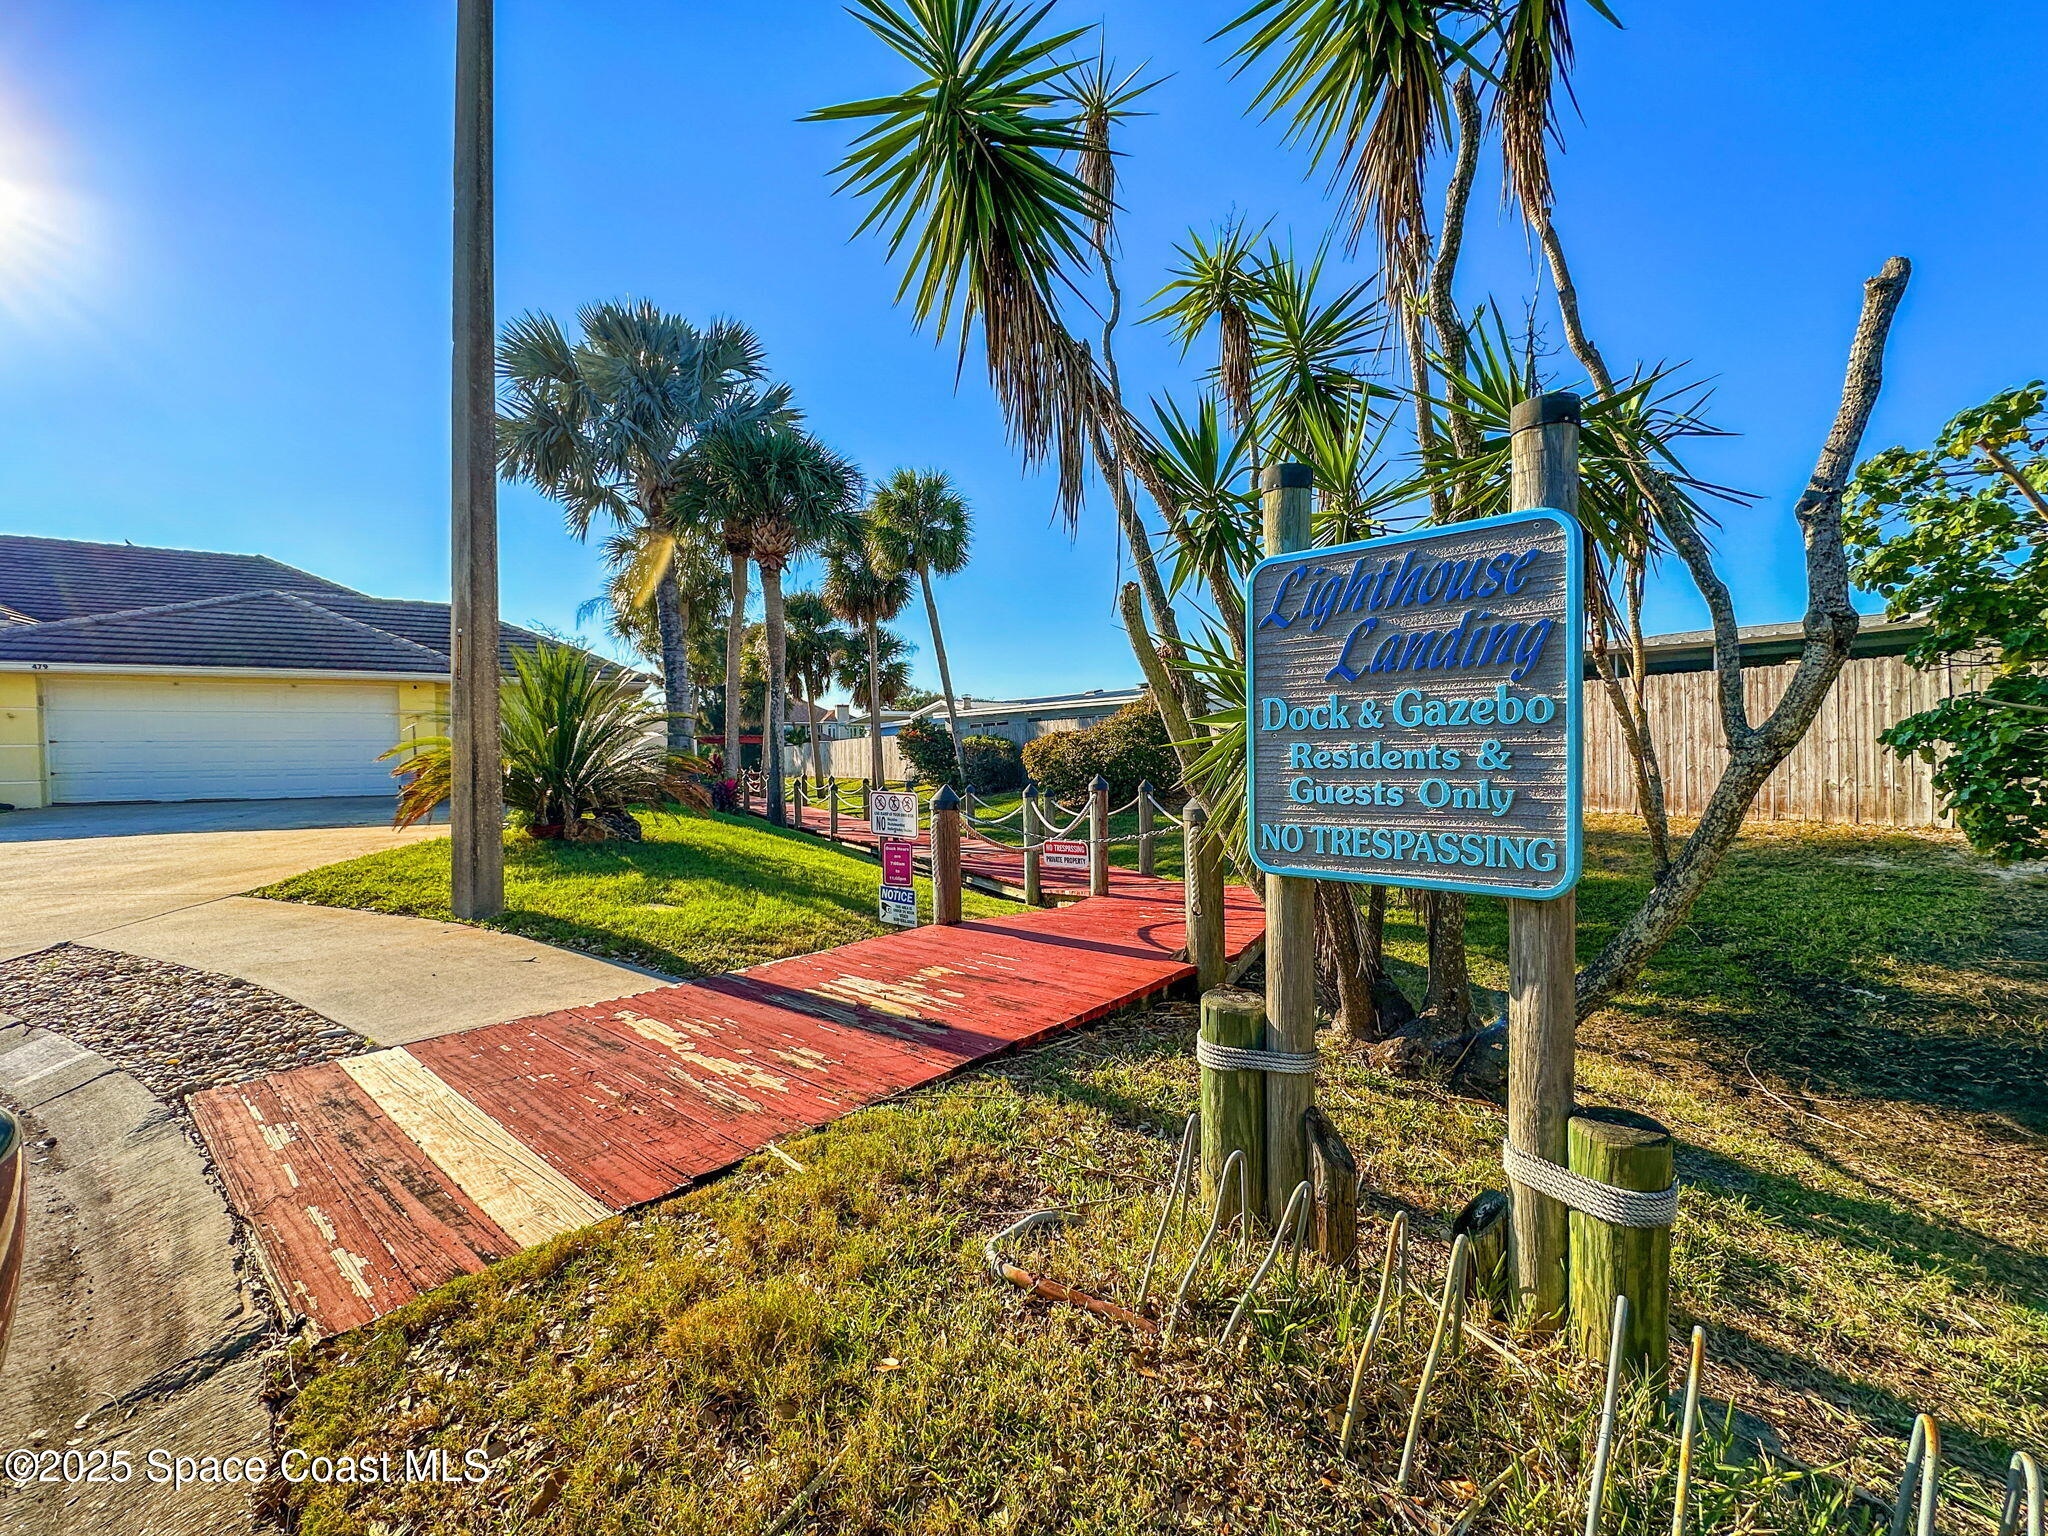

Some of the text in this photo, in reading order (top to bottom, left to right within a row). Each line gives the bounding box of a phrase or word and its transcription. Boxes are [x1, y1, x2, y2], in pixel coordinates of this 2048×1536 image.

[1258, 549, 1540, 632] Lighthouse
[1325, 609, 1554, 683] Landing
[1262, 684, 1554, 731] Dock & Gazebo
[1290, 740, 1512, 770] Residents &
[1290, 776, 1516, 817] Guests Only
[876, 816, 886, 830] NO
[1054, 844, 1085, 853] TRESPASSING
[1260, 824, 1557, 872] NO TRESPASSING
[882, 889, 913, 903] NOTICE
